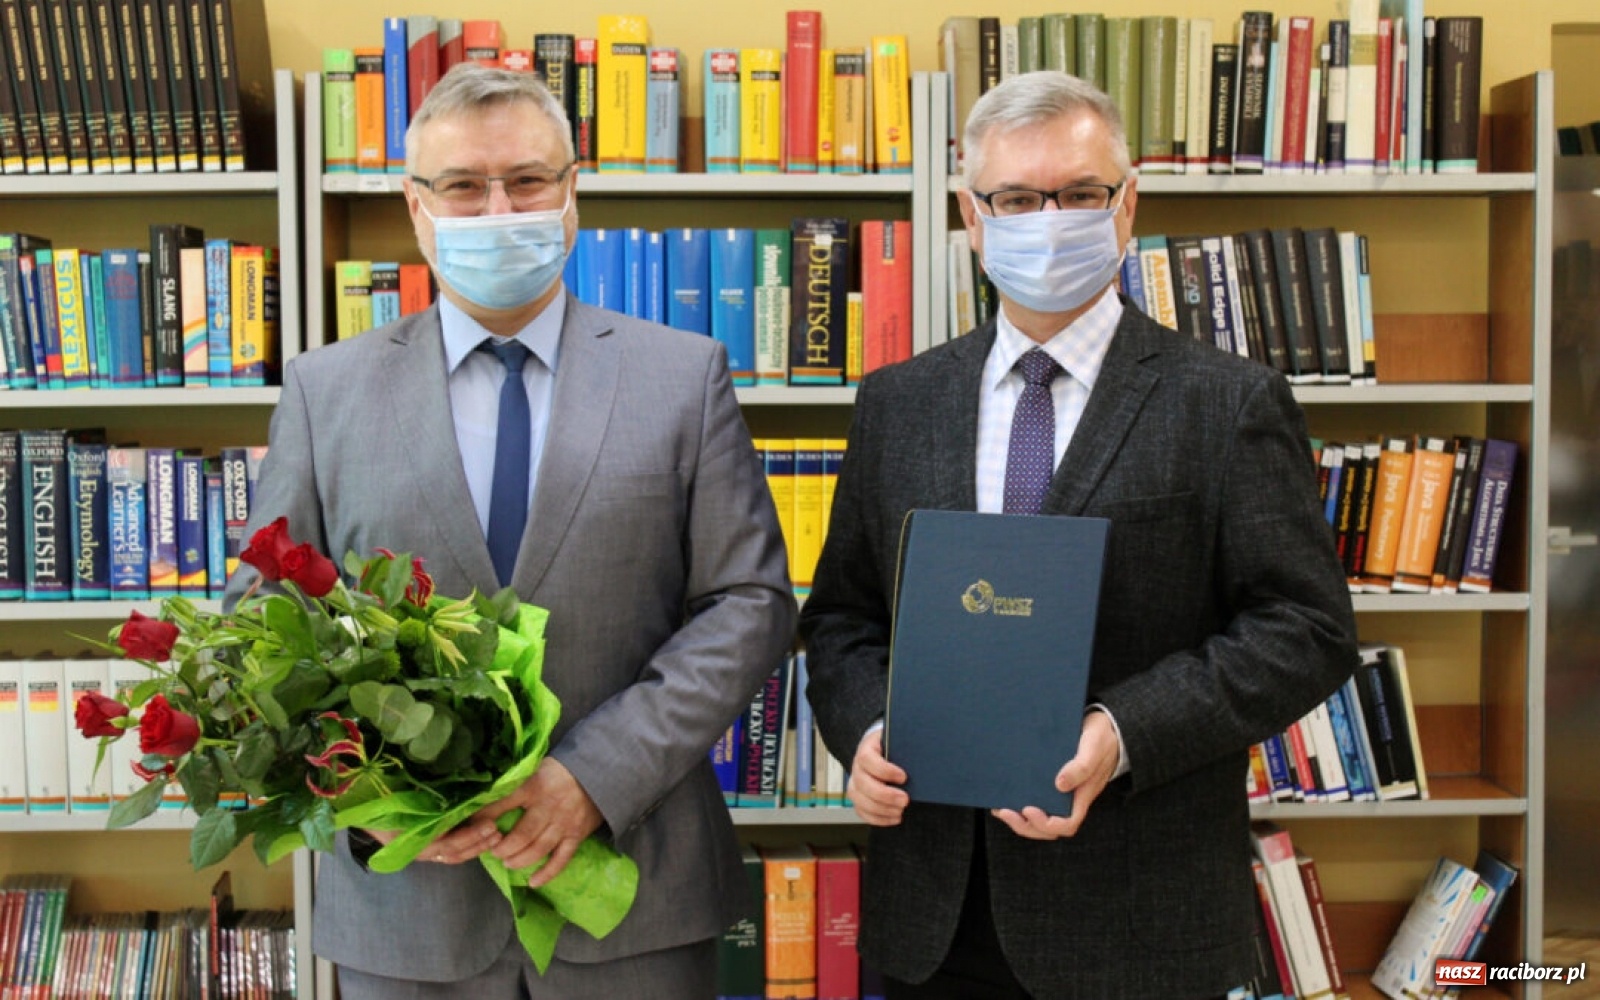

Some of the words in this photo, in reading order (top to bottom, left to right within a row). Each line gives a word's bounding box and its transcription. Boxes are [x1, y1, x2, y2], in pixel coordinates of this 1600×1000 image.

[613, 45, 641, 54] DUDEN
[247, 260, 255, 321] LONGMAN
[1208, 250, 1222, 283] olid
[57, 258, 81, 371] LEXICUS
[162, 278, 176, 321] SLANG
[806, 244, 832, 365] DEUTSCH
[1211, 285, 1226, 330] Edge
[68, 450, 105, 463] Oxford
[128, 480, 143, 552] Advanced
[159, 454, 174, 545] LONGMAN
[189, 461, 198, 521] LONGMAN
[233, 459, 247, 521] OXFORD
[33, 465, 56, 579] ENGLISH
[75, 479, 99, 582] Etymology
